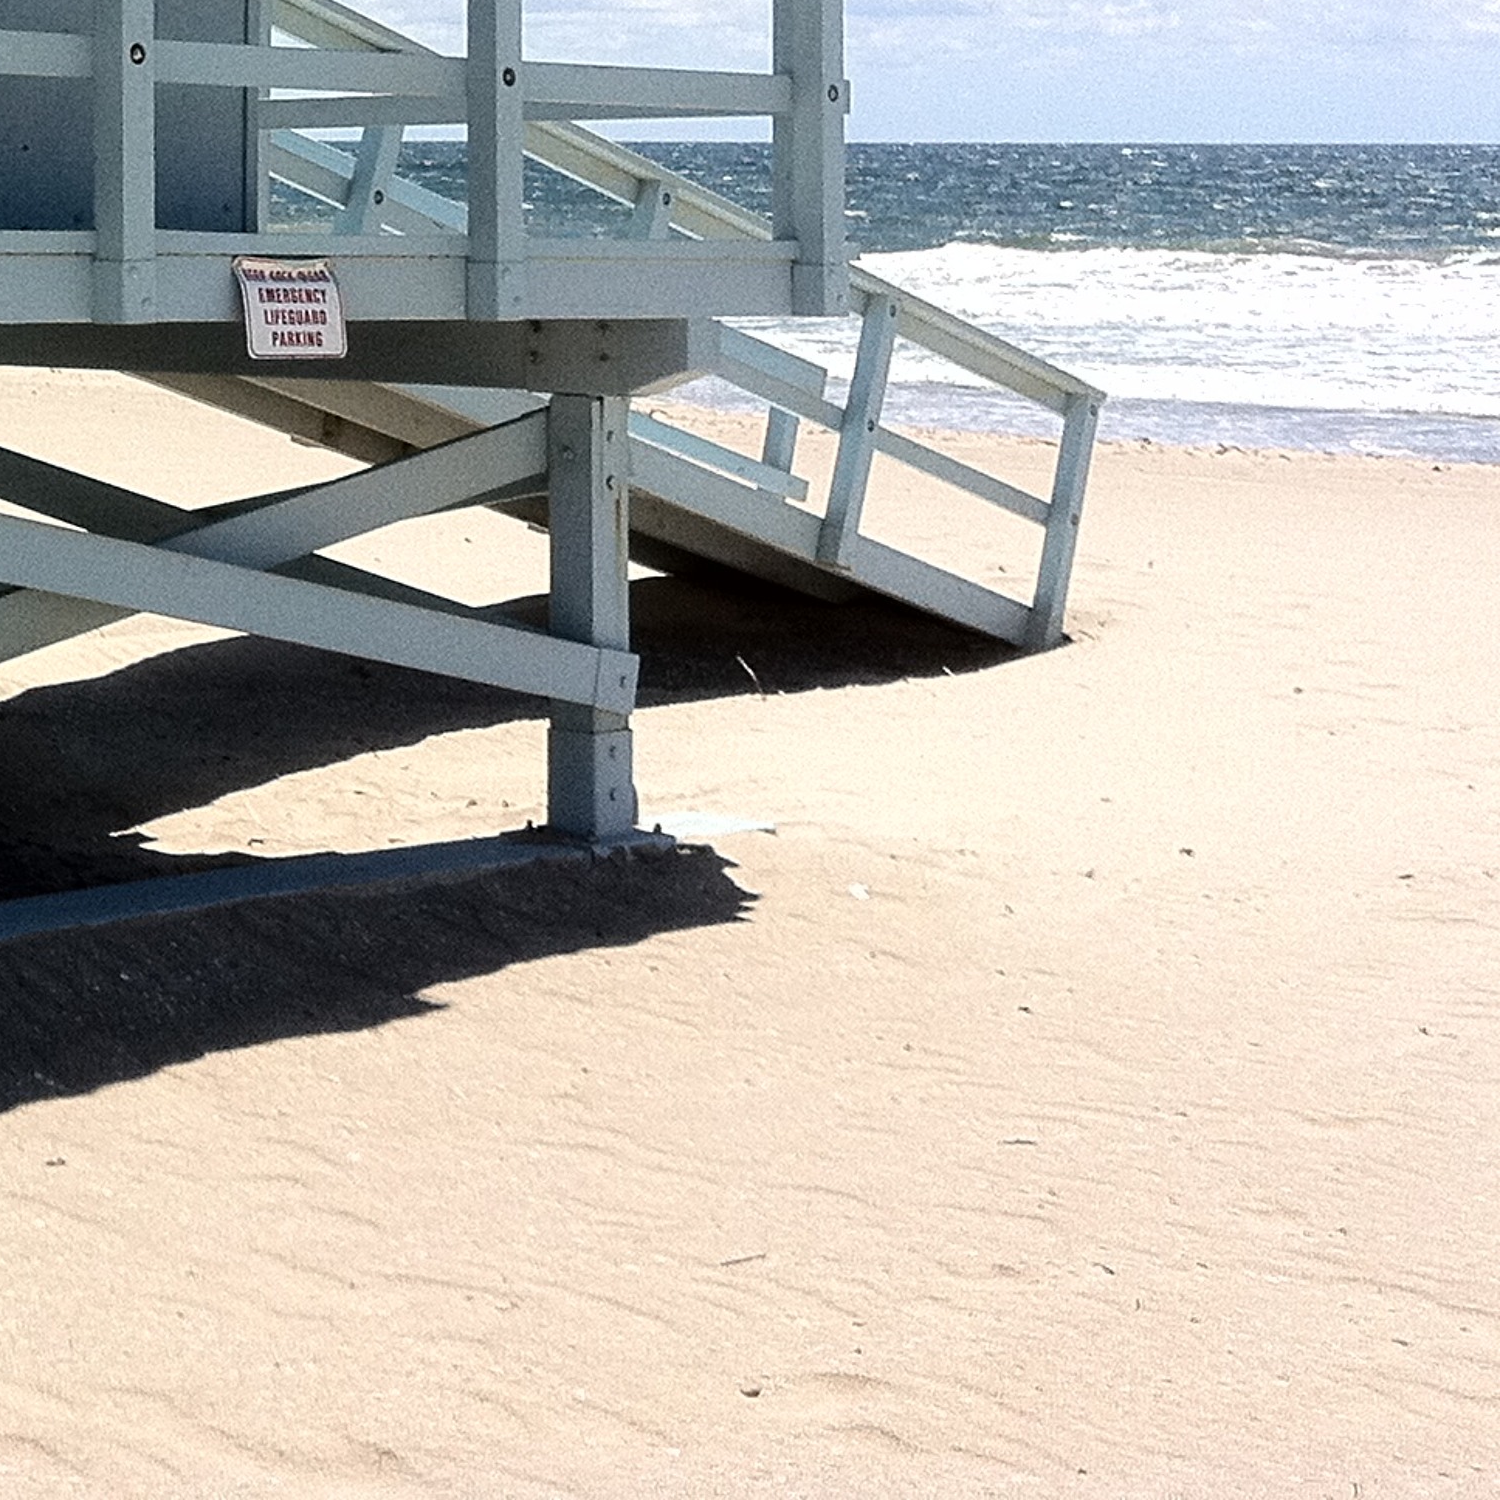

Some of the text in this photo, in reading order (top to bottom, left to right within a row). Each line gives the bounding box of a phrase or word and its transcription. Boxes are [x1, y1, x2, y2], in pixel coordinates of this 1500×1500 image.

[258, 287, 326, 304] EMERGENCY
[263, 308, 327, 325] LIFEGUARD
[271, 331, 323, 347] PARKING
